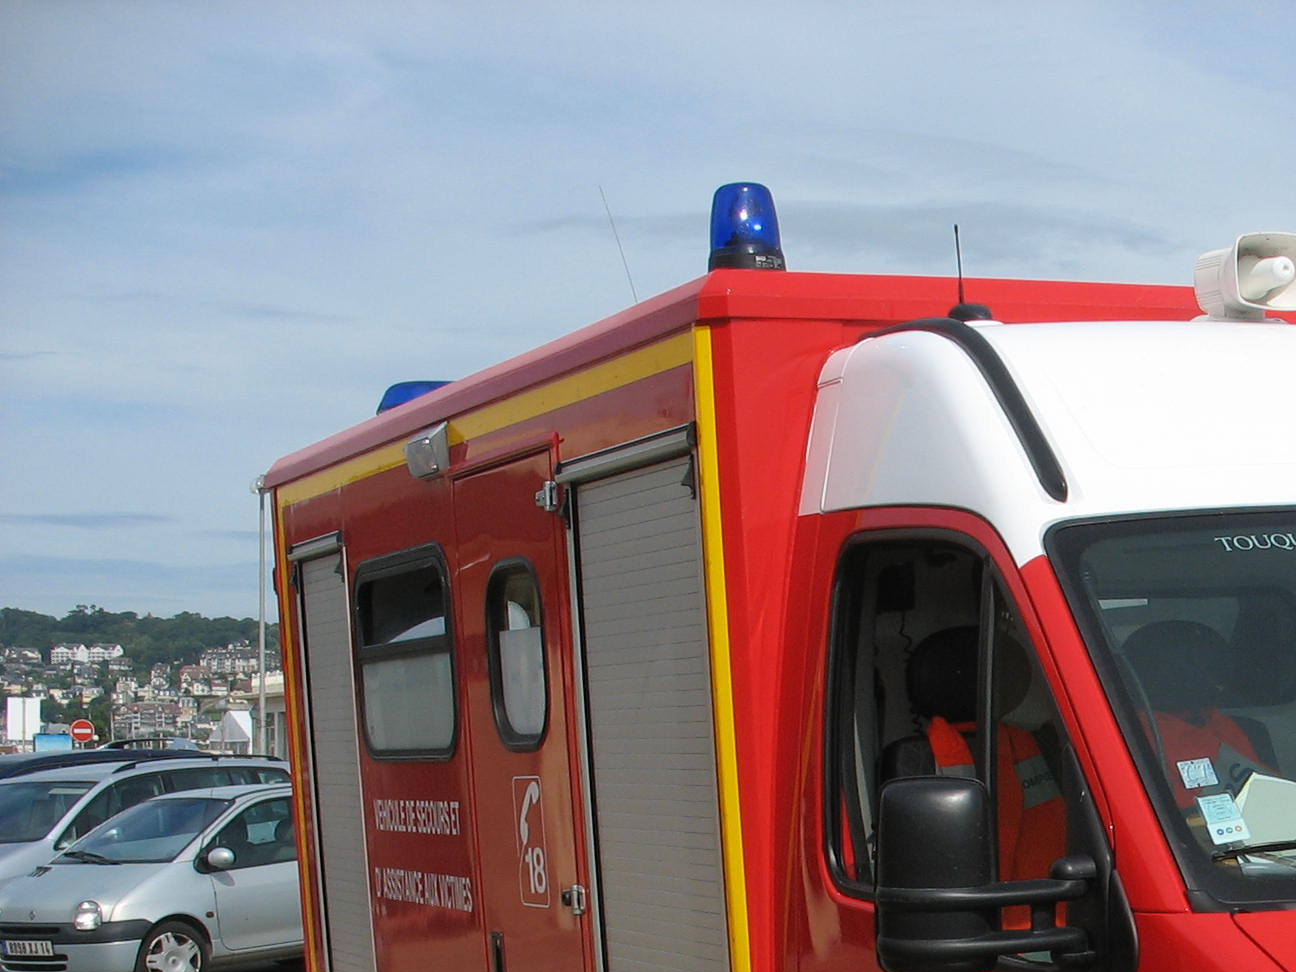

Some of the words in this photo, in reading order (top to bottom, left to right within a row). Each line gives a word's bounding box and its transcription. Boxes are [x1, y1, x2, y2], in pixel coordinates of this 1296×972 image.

[416, 800, 451, 836] SECOURS
[450, 801, 461, 836] ET
[524, 847, 547, 895] 18
[438, 874, 473, 913] VICTIMES
